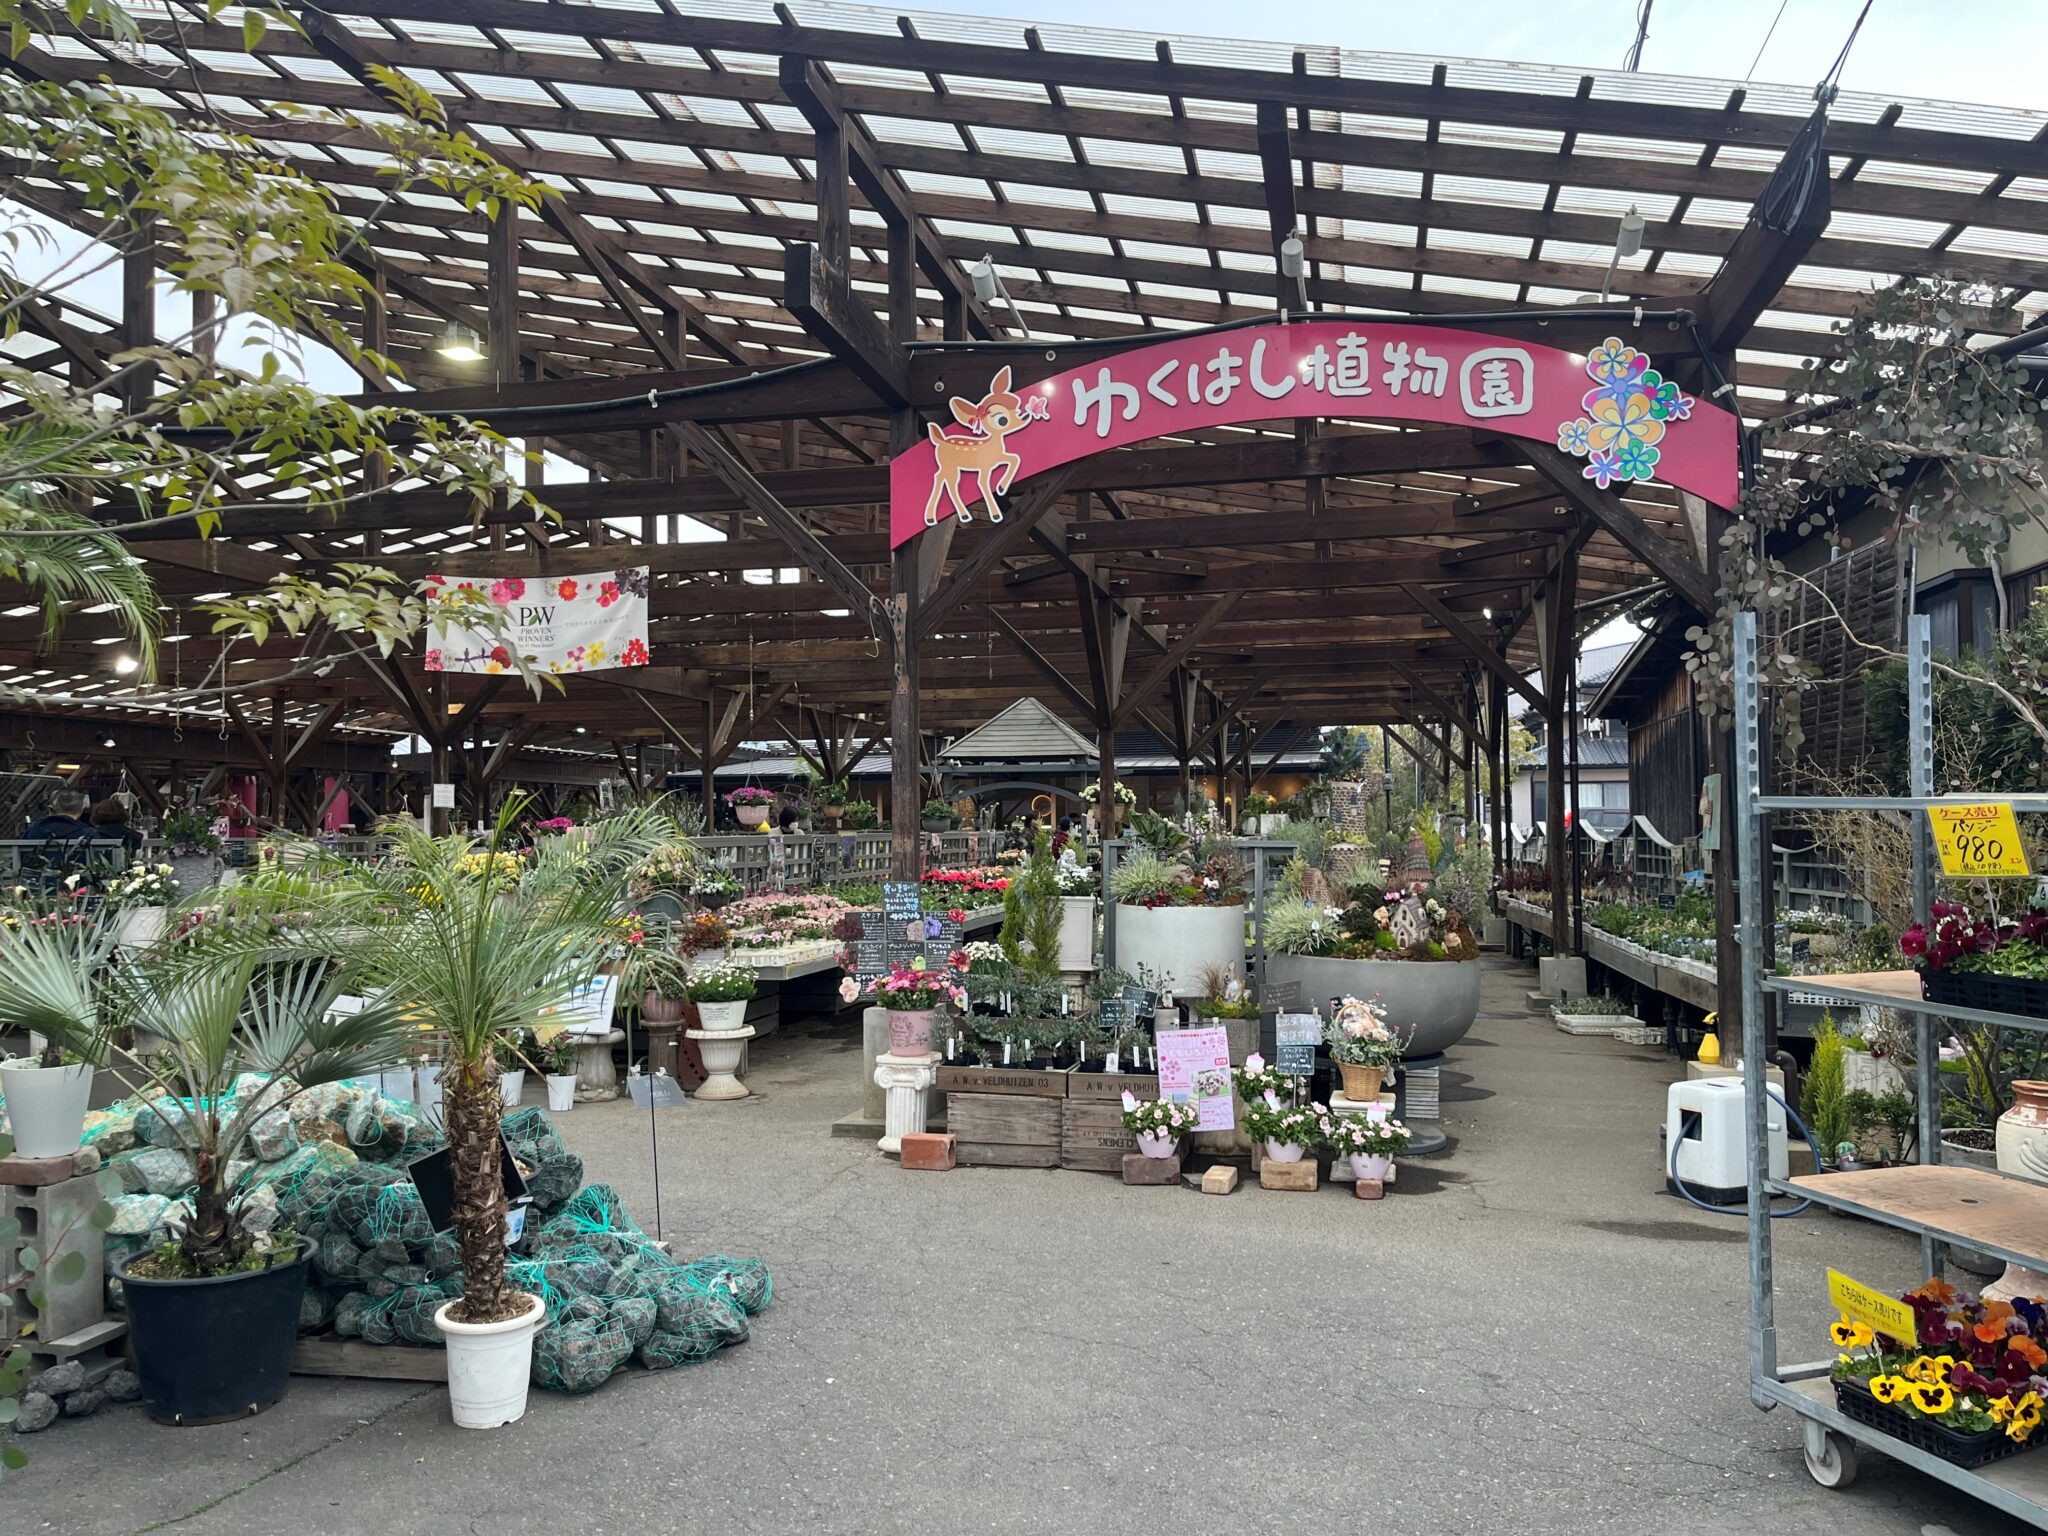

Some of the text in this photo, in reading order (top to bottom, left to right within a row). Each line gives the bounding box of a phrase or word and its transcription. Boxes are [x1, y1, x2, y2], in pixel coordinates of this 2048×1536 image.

[1071, 332, 1534, 437] ゆくはし植物園
[520, 606, 556, 627] PW
[521, 627, 552, 635] PROVEN
[517, 635, 555, 643] WINNERS
[1940, 806, 1998, 818] ケース売り
[1952, 819, 1997, 834] パンジー
[1957, 834, 2003, 863] 980
[952, 1074, 959, 1084] A
[963, 1075, 969, 1083] W
[983, 1075, 1034, 1087] VELDHUIZEN
[1086, 1081, 1093, 1091] A
[1841, 1284, 1903, 1325] こちらはケース売りです
